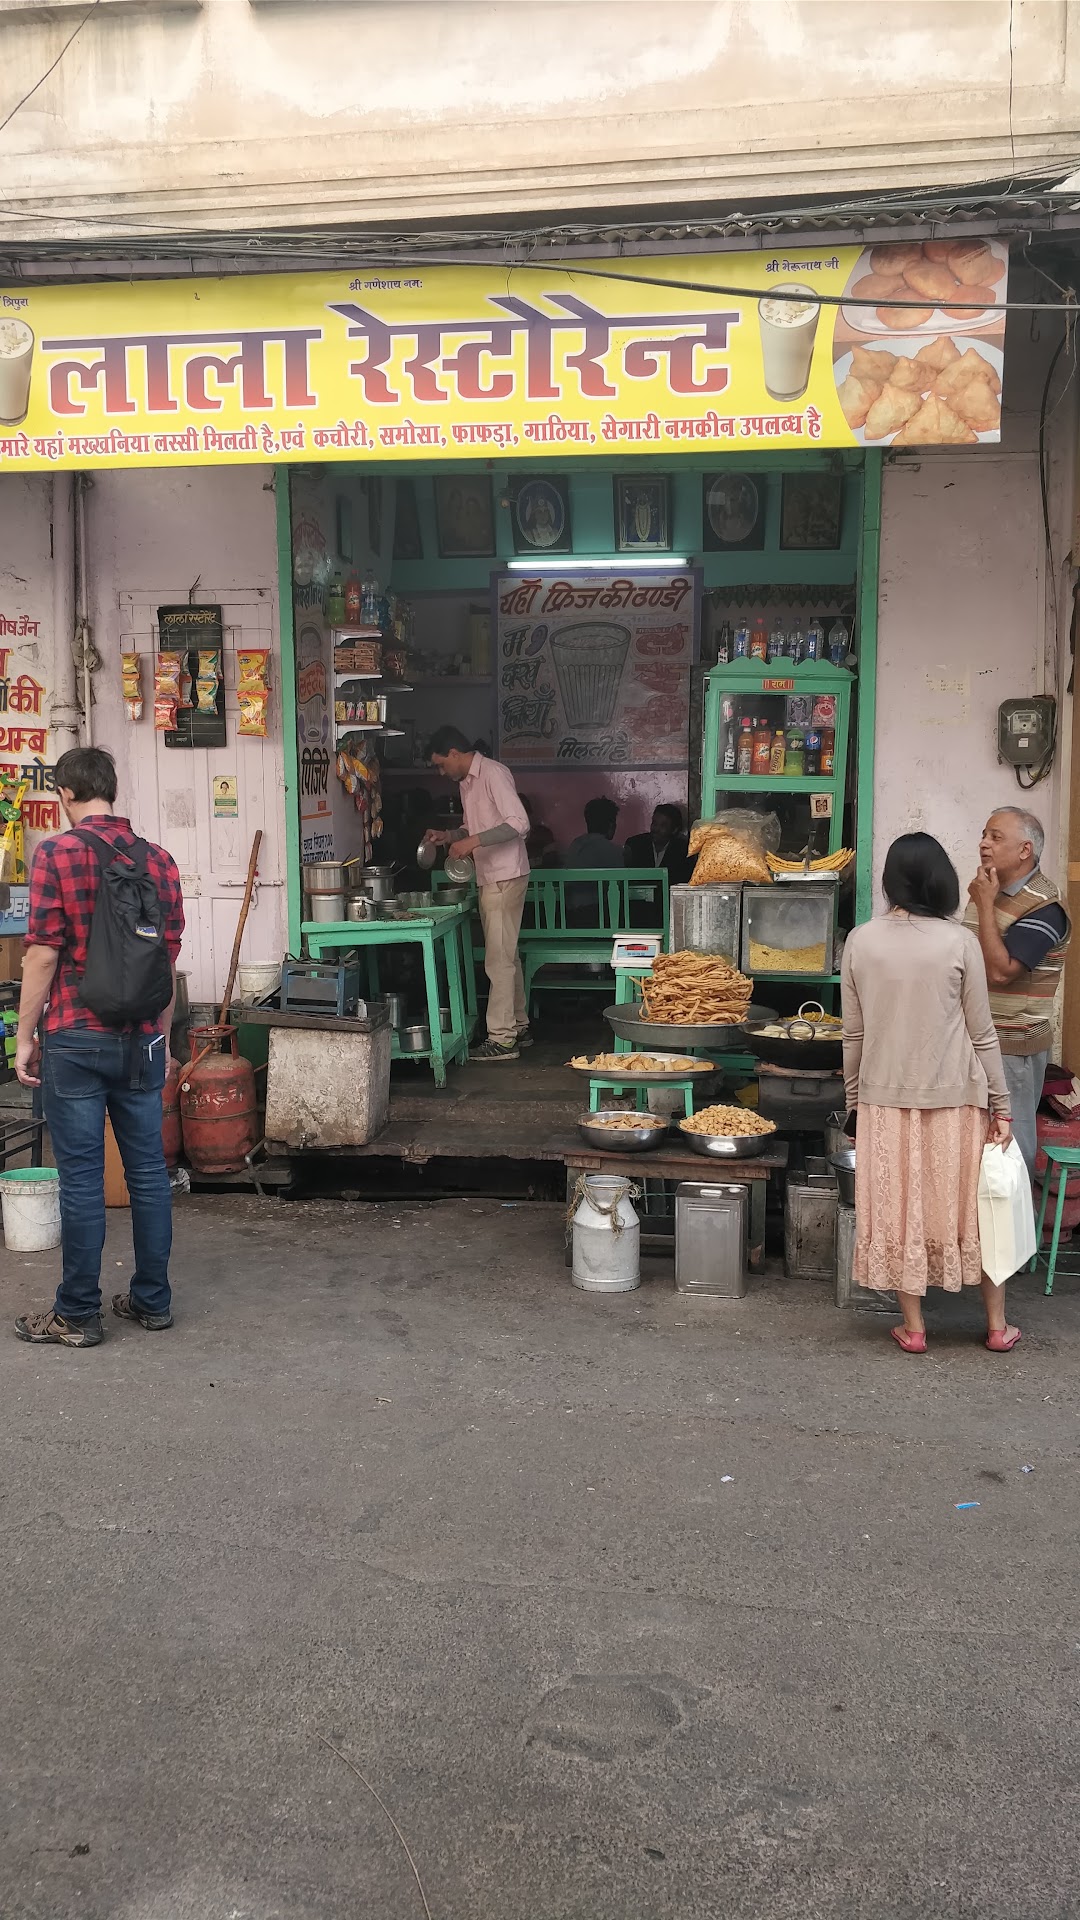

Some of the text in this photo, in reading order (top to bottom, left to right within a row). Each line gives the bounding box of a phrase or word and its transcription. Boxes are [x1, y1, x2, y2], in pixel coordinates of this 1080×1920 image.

[765, 259, 780, 272] श्री
[824, 256, 840, 269] जी
[349, 278, 361, 290] श्री
[364, 278, 401, 290] गणेशाय
[42, 294, 740, 414] लाला रेस्टोरेन्ट
[0, 432, 30, 457] मारे
[33, 430, 65, 460] यहां
[154, 427, 200, 453] लस्सी
[203, 424, 258, 452] मिलती
[601, 411, 661, 440] सेगारी
[665, 411, 736, 438] नमकीन
[740, 414, 803, 436] उपलब्ध
[806, 406, 821, 438] है
[599, 579, 637, 611] की
[9, 674, 44, 713] की
[771, 680, 786, 689] राम
